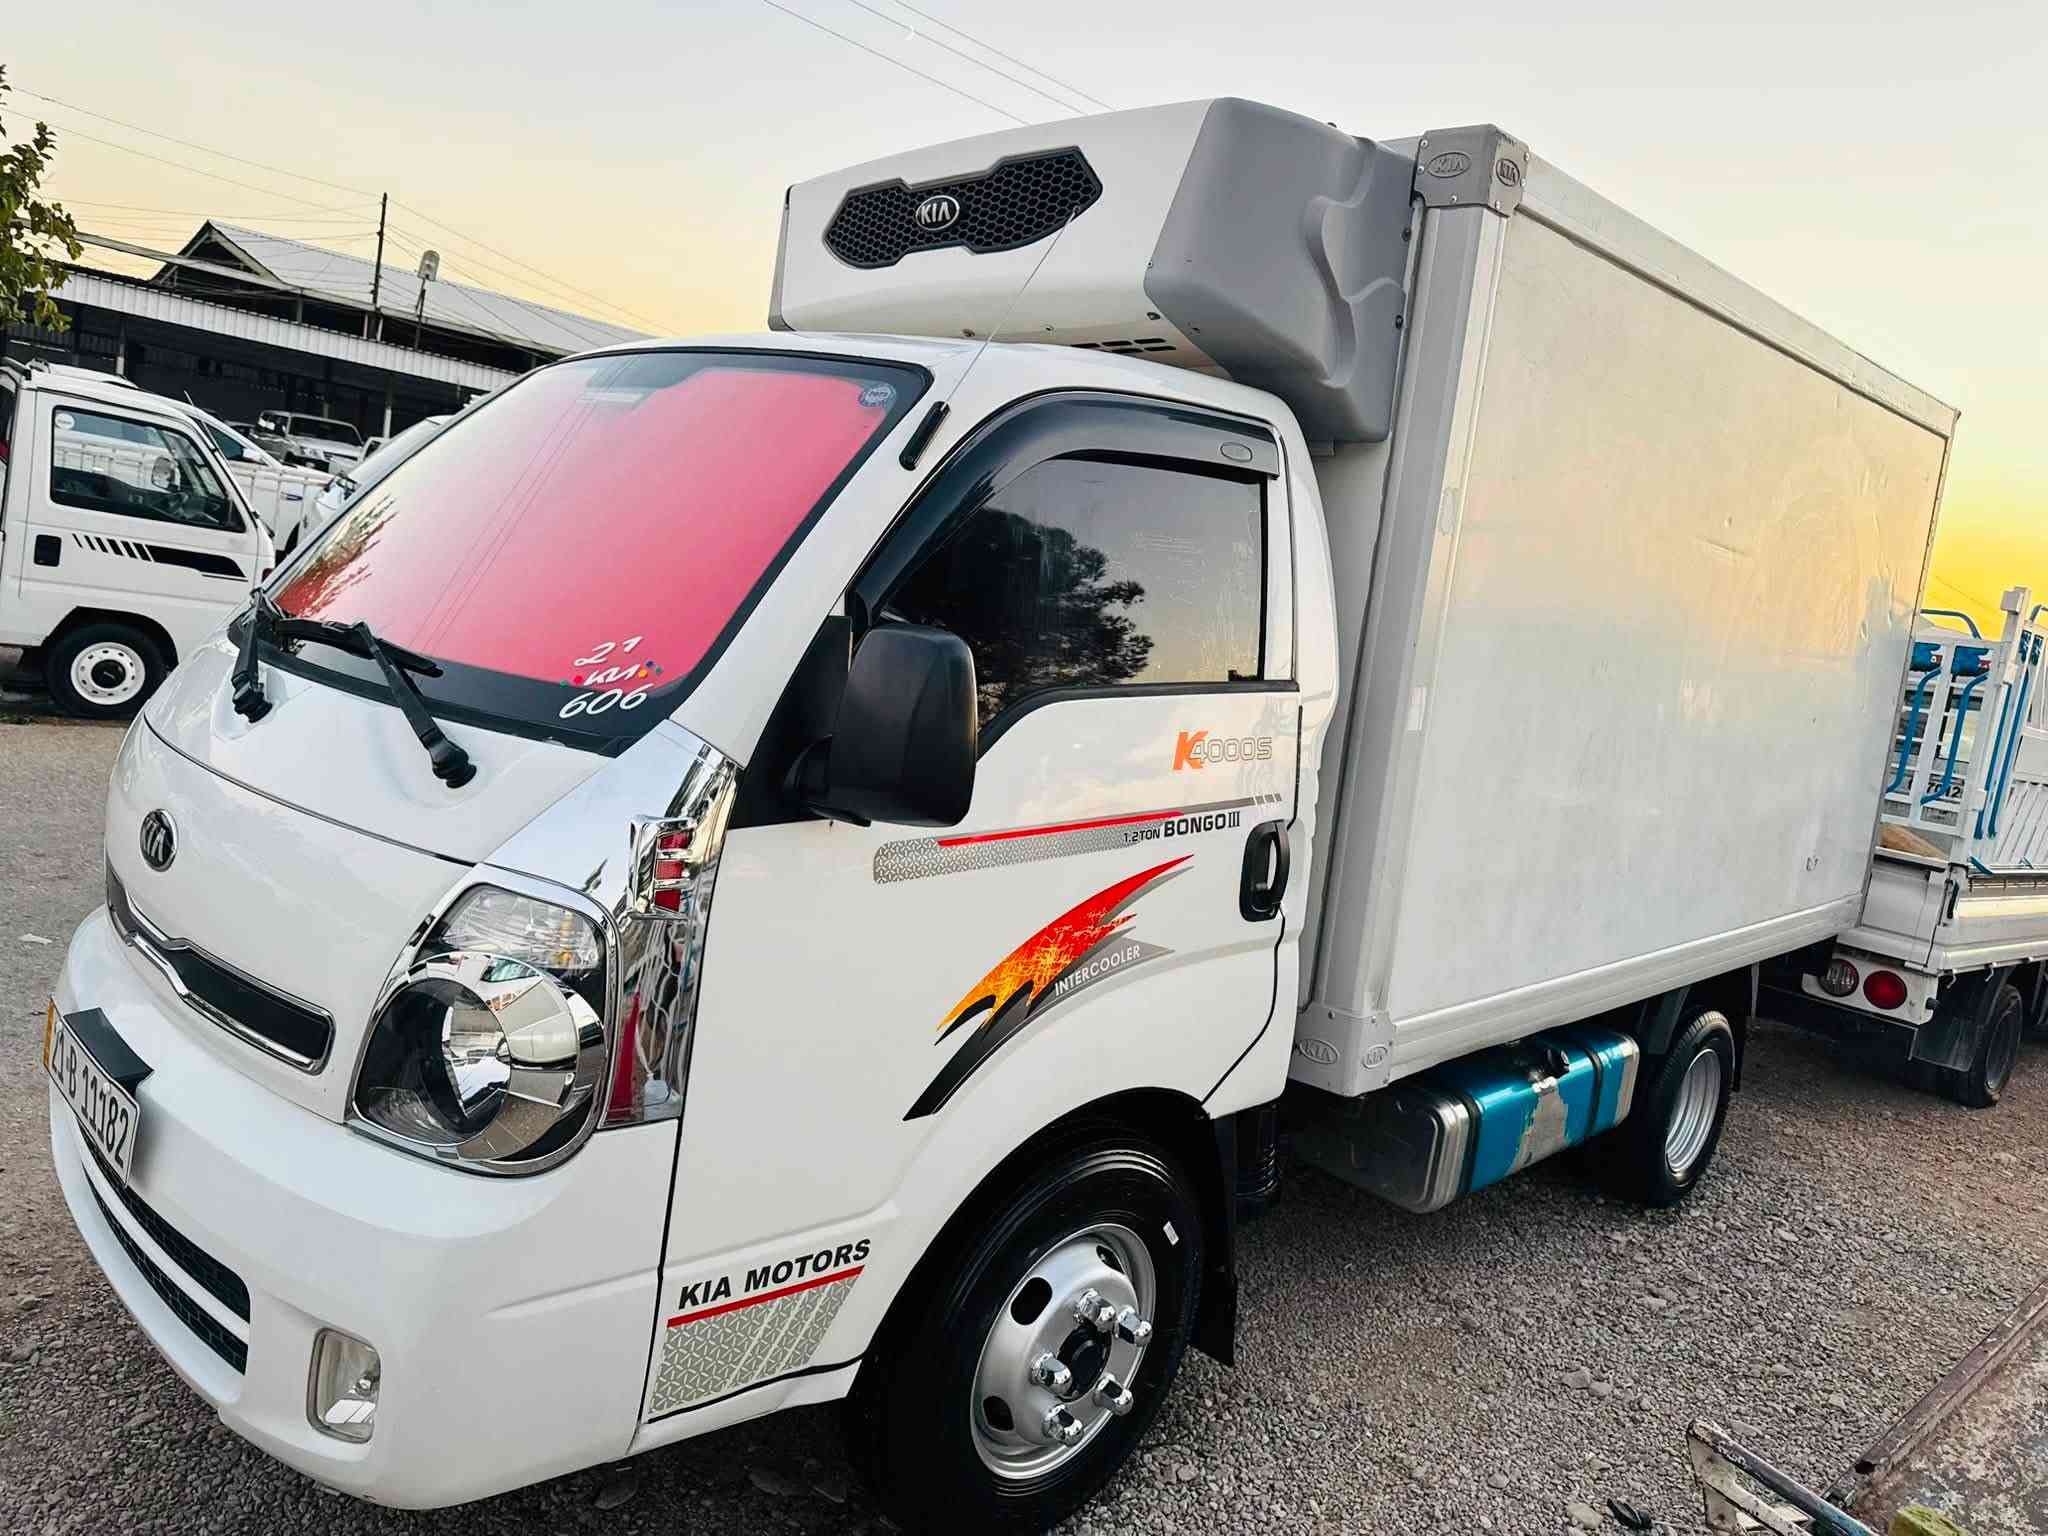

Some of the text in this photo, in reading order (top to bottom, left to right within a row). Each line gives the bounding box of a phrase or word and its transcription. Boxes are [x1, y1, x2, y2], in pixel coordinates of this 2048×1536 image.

[920, 202, 951, 225] KIA
[559, 683, 655, 719] 606
[1055, 944, 1141, 997] INTERCOOLER
[81, 1065, 129, 1169] 11182
[678, 1238, 871, 1310] KIA MOTORS
